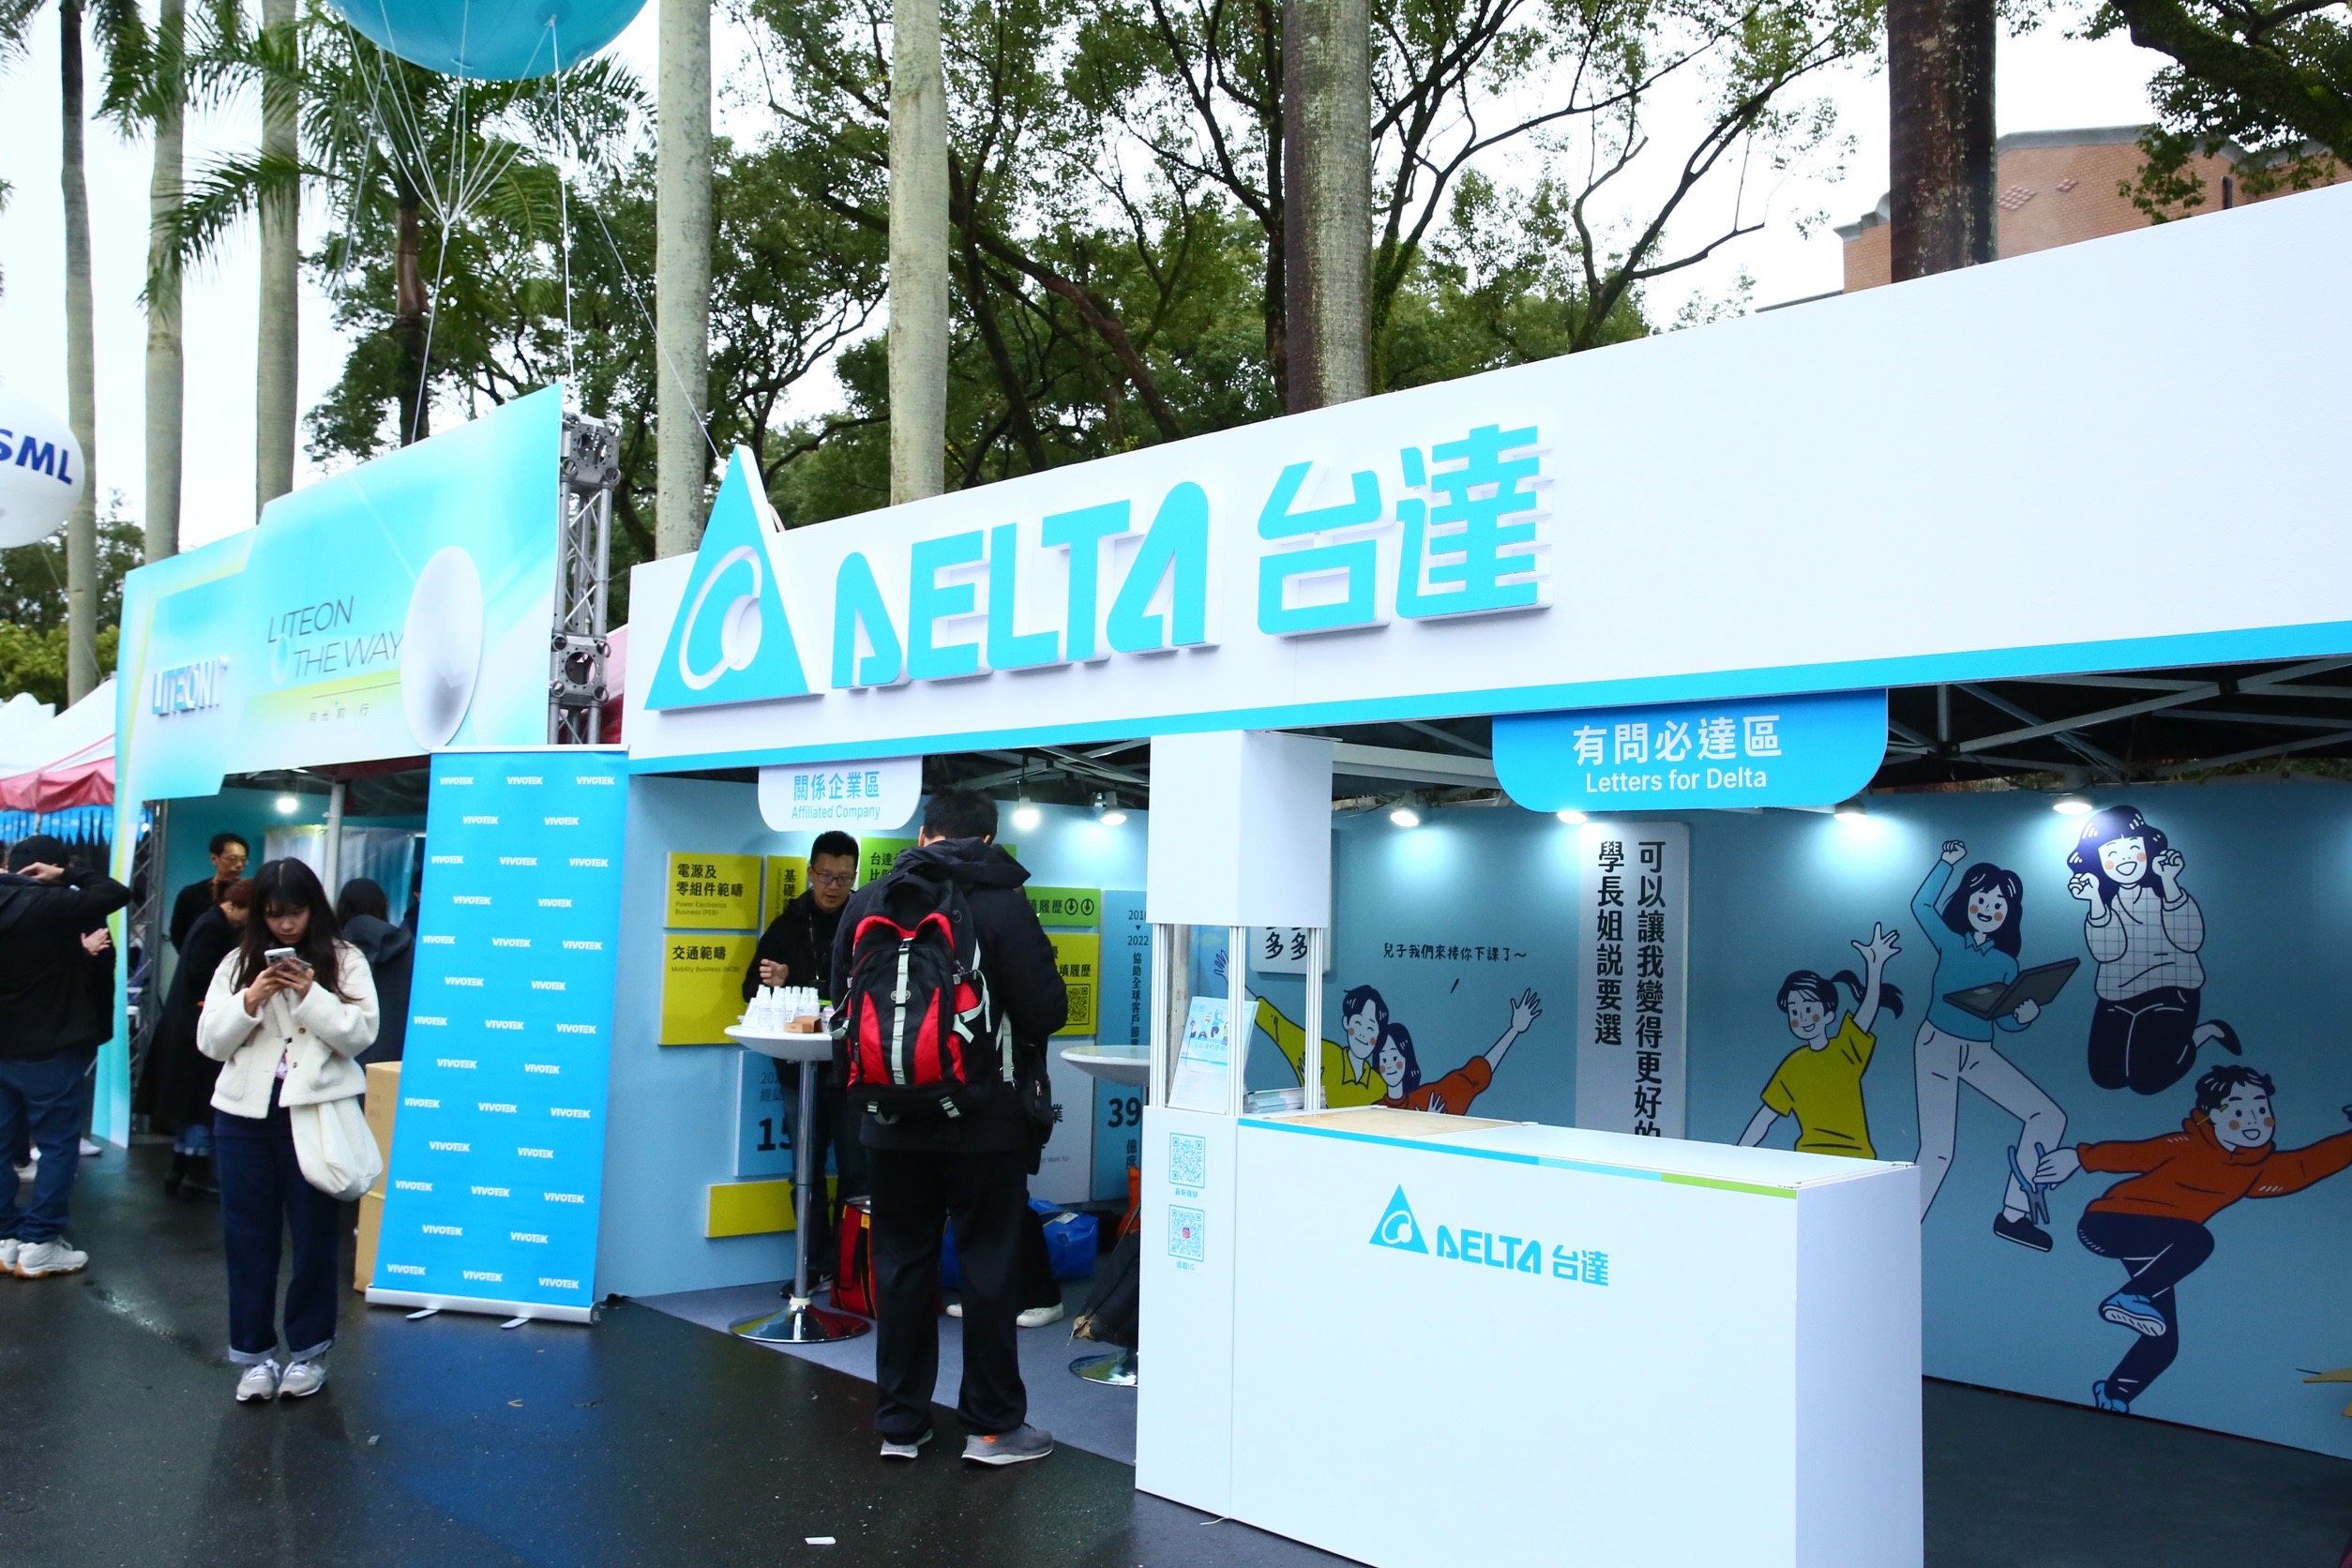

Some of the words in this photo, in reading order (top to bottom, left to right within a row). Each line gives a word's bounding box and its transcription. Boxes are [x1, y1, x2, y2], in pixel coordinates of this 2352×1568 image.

[1257, 423, 1544, 636] 台達
[832, 480, 1214, 690] DELTA
[267, 595, 354, 643] LITEON
[293, 641, 340, 678] THE
[344, 630, 404, 668] WAY
[1573, 715, 1783, 767] 有問必達區
[439, 776, 474, 785] VIVOTEK
[506, 776, 543, 786] VIVOTEK
[576, 776, 615, 786] VIVOTEK
[793, 770, 881, 801] 關係企業區
[1586, 772, 1663, 793] Letters
[1668, 768, 1700, 791] for
[1706, 766, 1768, 790] Delta
[792, 807, 833, 820] Affiliated
[836, 805, 881, 822] Company
[462, 816, 499, 825] VIVOTEK
[543, 817, 580, 825] VIVOTEK
[430, 855, 464, 865] VIVOTEK
[499, 856, 537, 867] VIVOTEK
[568, 857, 609, 867] VIVOTEK
[677, 864, 716, 879] 電源及
[676, 882, 743, 897] 零組件範疇
[452, 896, 491, 906] VIVOTEK
[537, 898, 572, 908] VIVOTEK
[422, 935, 456, 944] VIVOTEK
[491, 938, 531, 948] VIVOTEK
[562, 940, 603, 951] VIVOTEK
[1127, 936, 1149, 946] 2022
[672, 946, 727, 961] 交通範疇
[445, 976, 485, 988] VIVOTEK
[531, 981, 566, 991] VIVOTEK
[414, 1016, 447, 1026] VIVOTEK
[485, 1019, 524, 1031] VIVOTEK
[555, 1023, 596, 1034] VIVOTEK
[436, 1058, 477, 1069] VIVOTEK
[524, 1063, 560, 1075] VIVOTEK
[404, 1097, 441, 1108] VIVOTEK
[477, 1102, 518, 1113] VIVOTEK
[550, 1108, 591, 1119] VIVOTEK
[429, 1141, 471, 1153] VIVOTEK
[517, 1147, 554, 1159] VIVOTEK
[395, 1180, 433, 1192] VIVOTEK
[471, 1185, 510, 1198] VIVOTEK
[544, 1192, 585, 1204] VIVOTEK
[422, 1225, 463, 1236] VIVOTEK
[510, 1231, 549, 1244] VIVOTEK
[1437, 1224, 1542, 1275] DELTA
[386, 1263, 426, 1275] VIVOTEK
[1552, 1244, 1609, 1288] 台達
[462, 1270, 503, 1283] VIVOTEK
[538, 1277, 580, 1289] VIVOTEK
